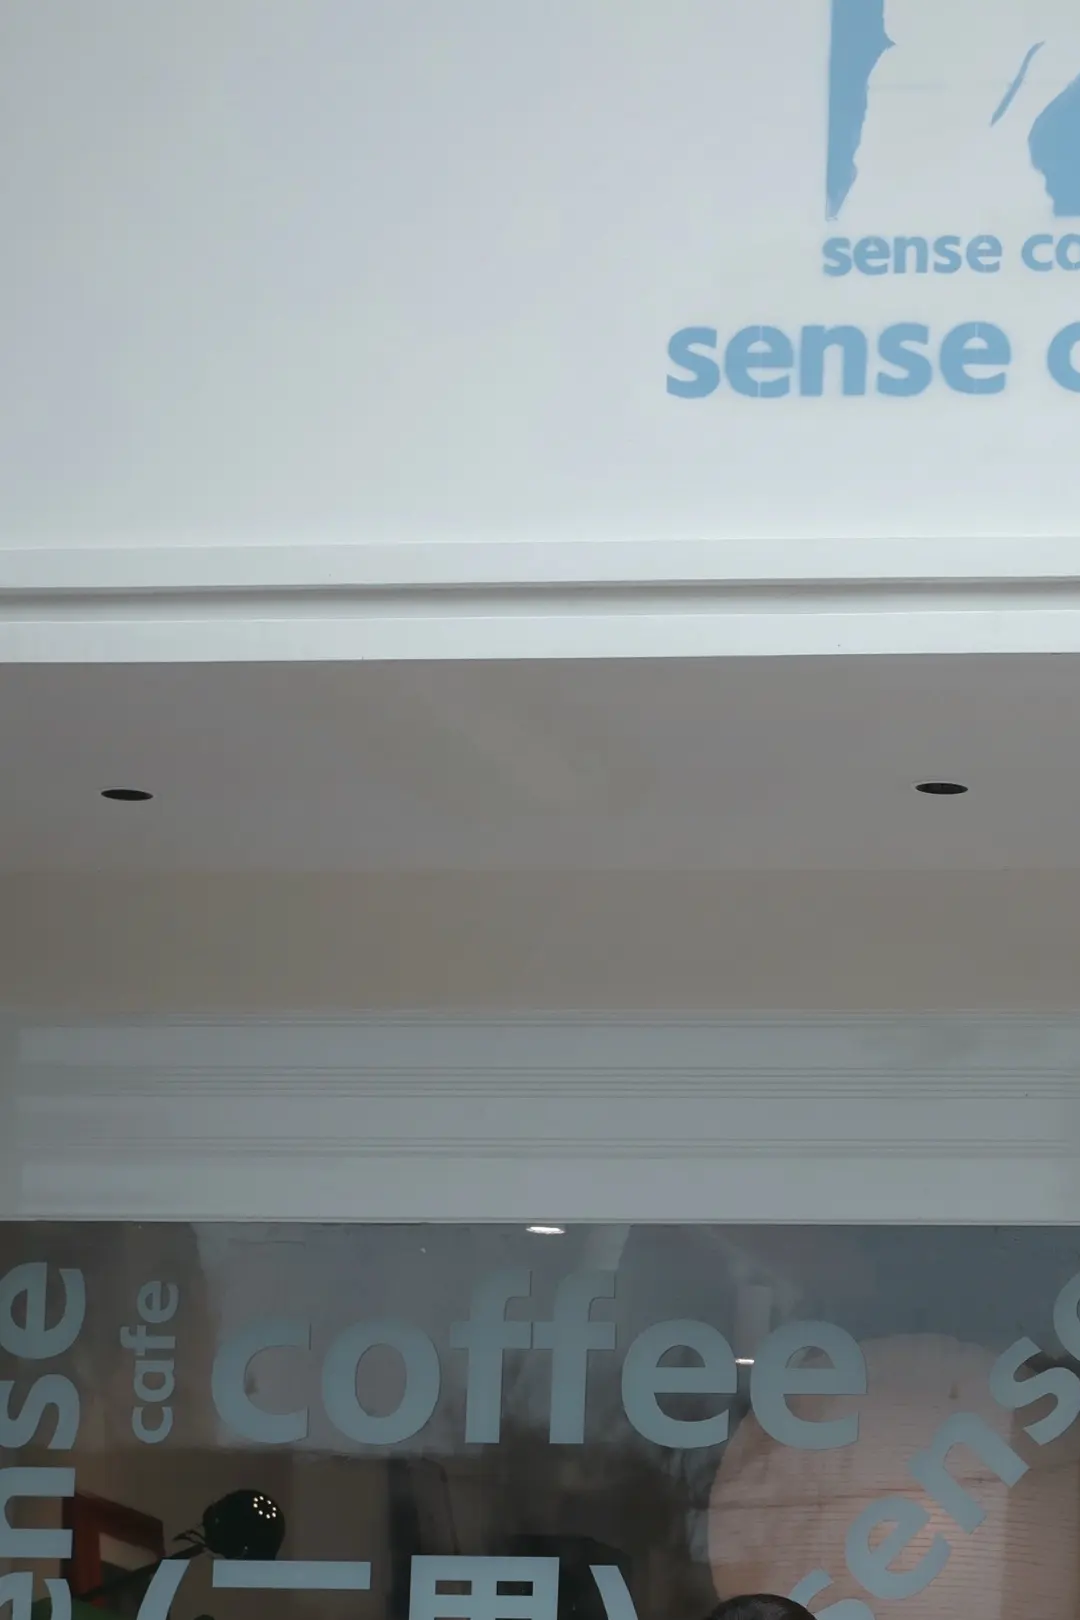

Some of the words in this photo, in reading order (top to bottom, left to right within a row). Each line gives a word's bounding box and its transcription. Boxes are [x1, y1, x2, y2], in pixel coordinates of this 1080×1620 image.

[822, 233, 1003, 277] sense
[666, 319, 1012, 399] sense
[120, 1279, 179, 1444] cafe
[211, 1268, 868, 1451] coffee
